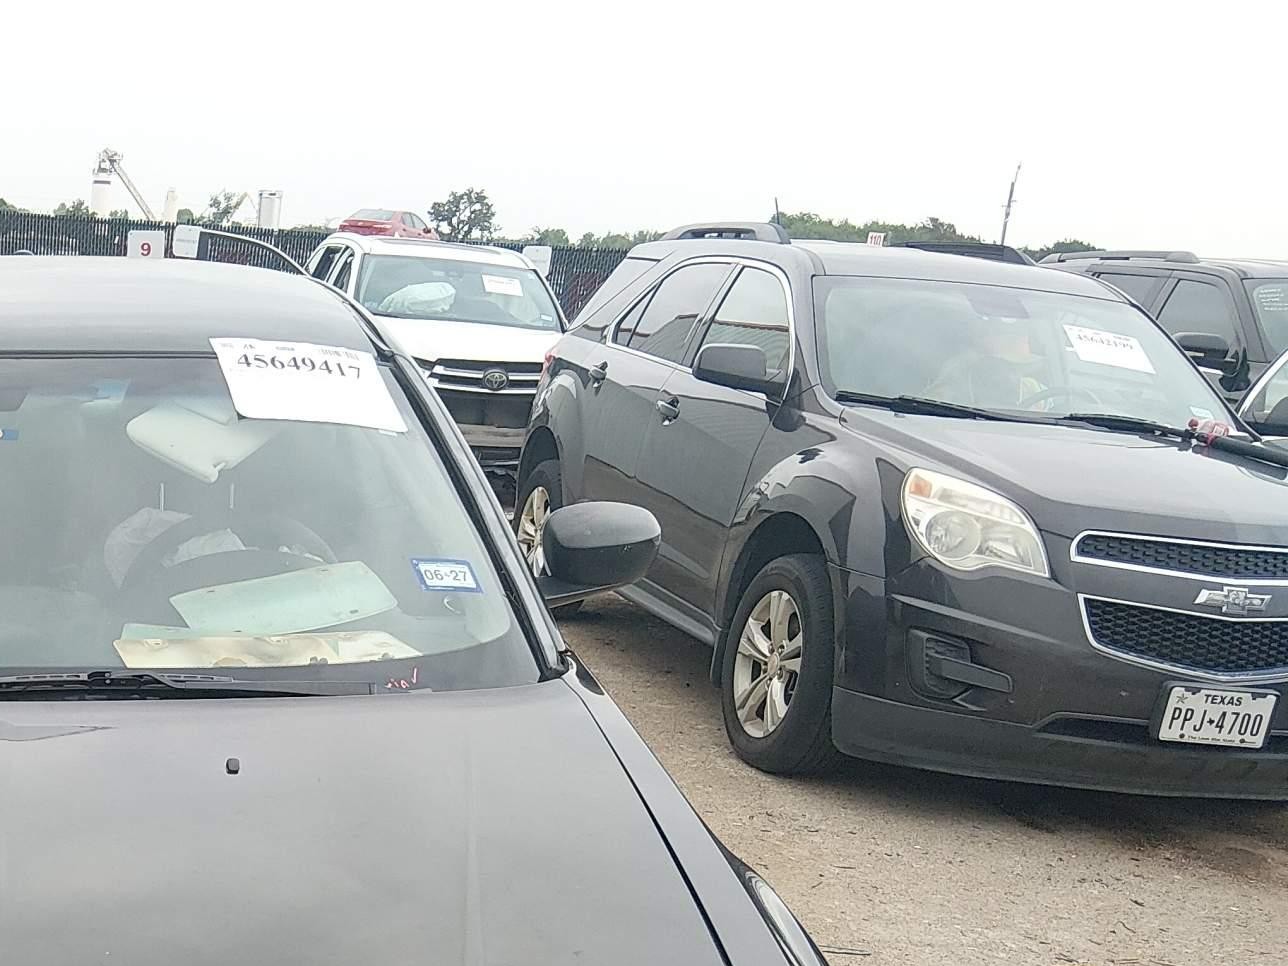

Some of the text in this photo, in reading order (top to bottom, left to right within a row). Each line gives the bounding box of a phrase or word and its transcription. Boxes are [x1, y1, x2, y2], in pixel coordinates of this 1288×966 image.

[140, 242, 151, 257] 9
[237, 353, 361, 380] 45649417
[1204, 694, 1243, 707] TEXAS
